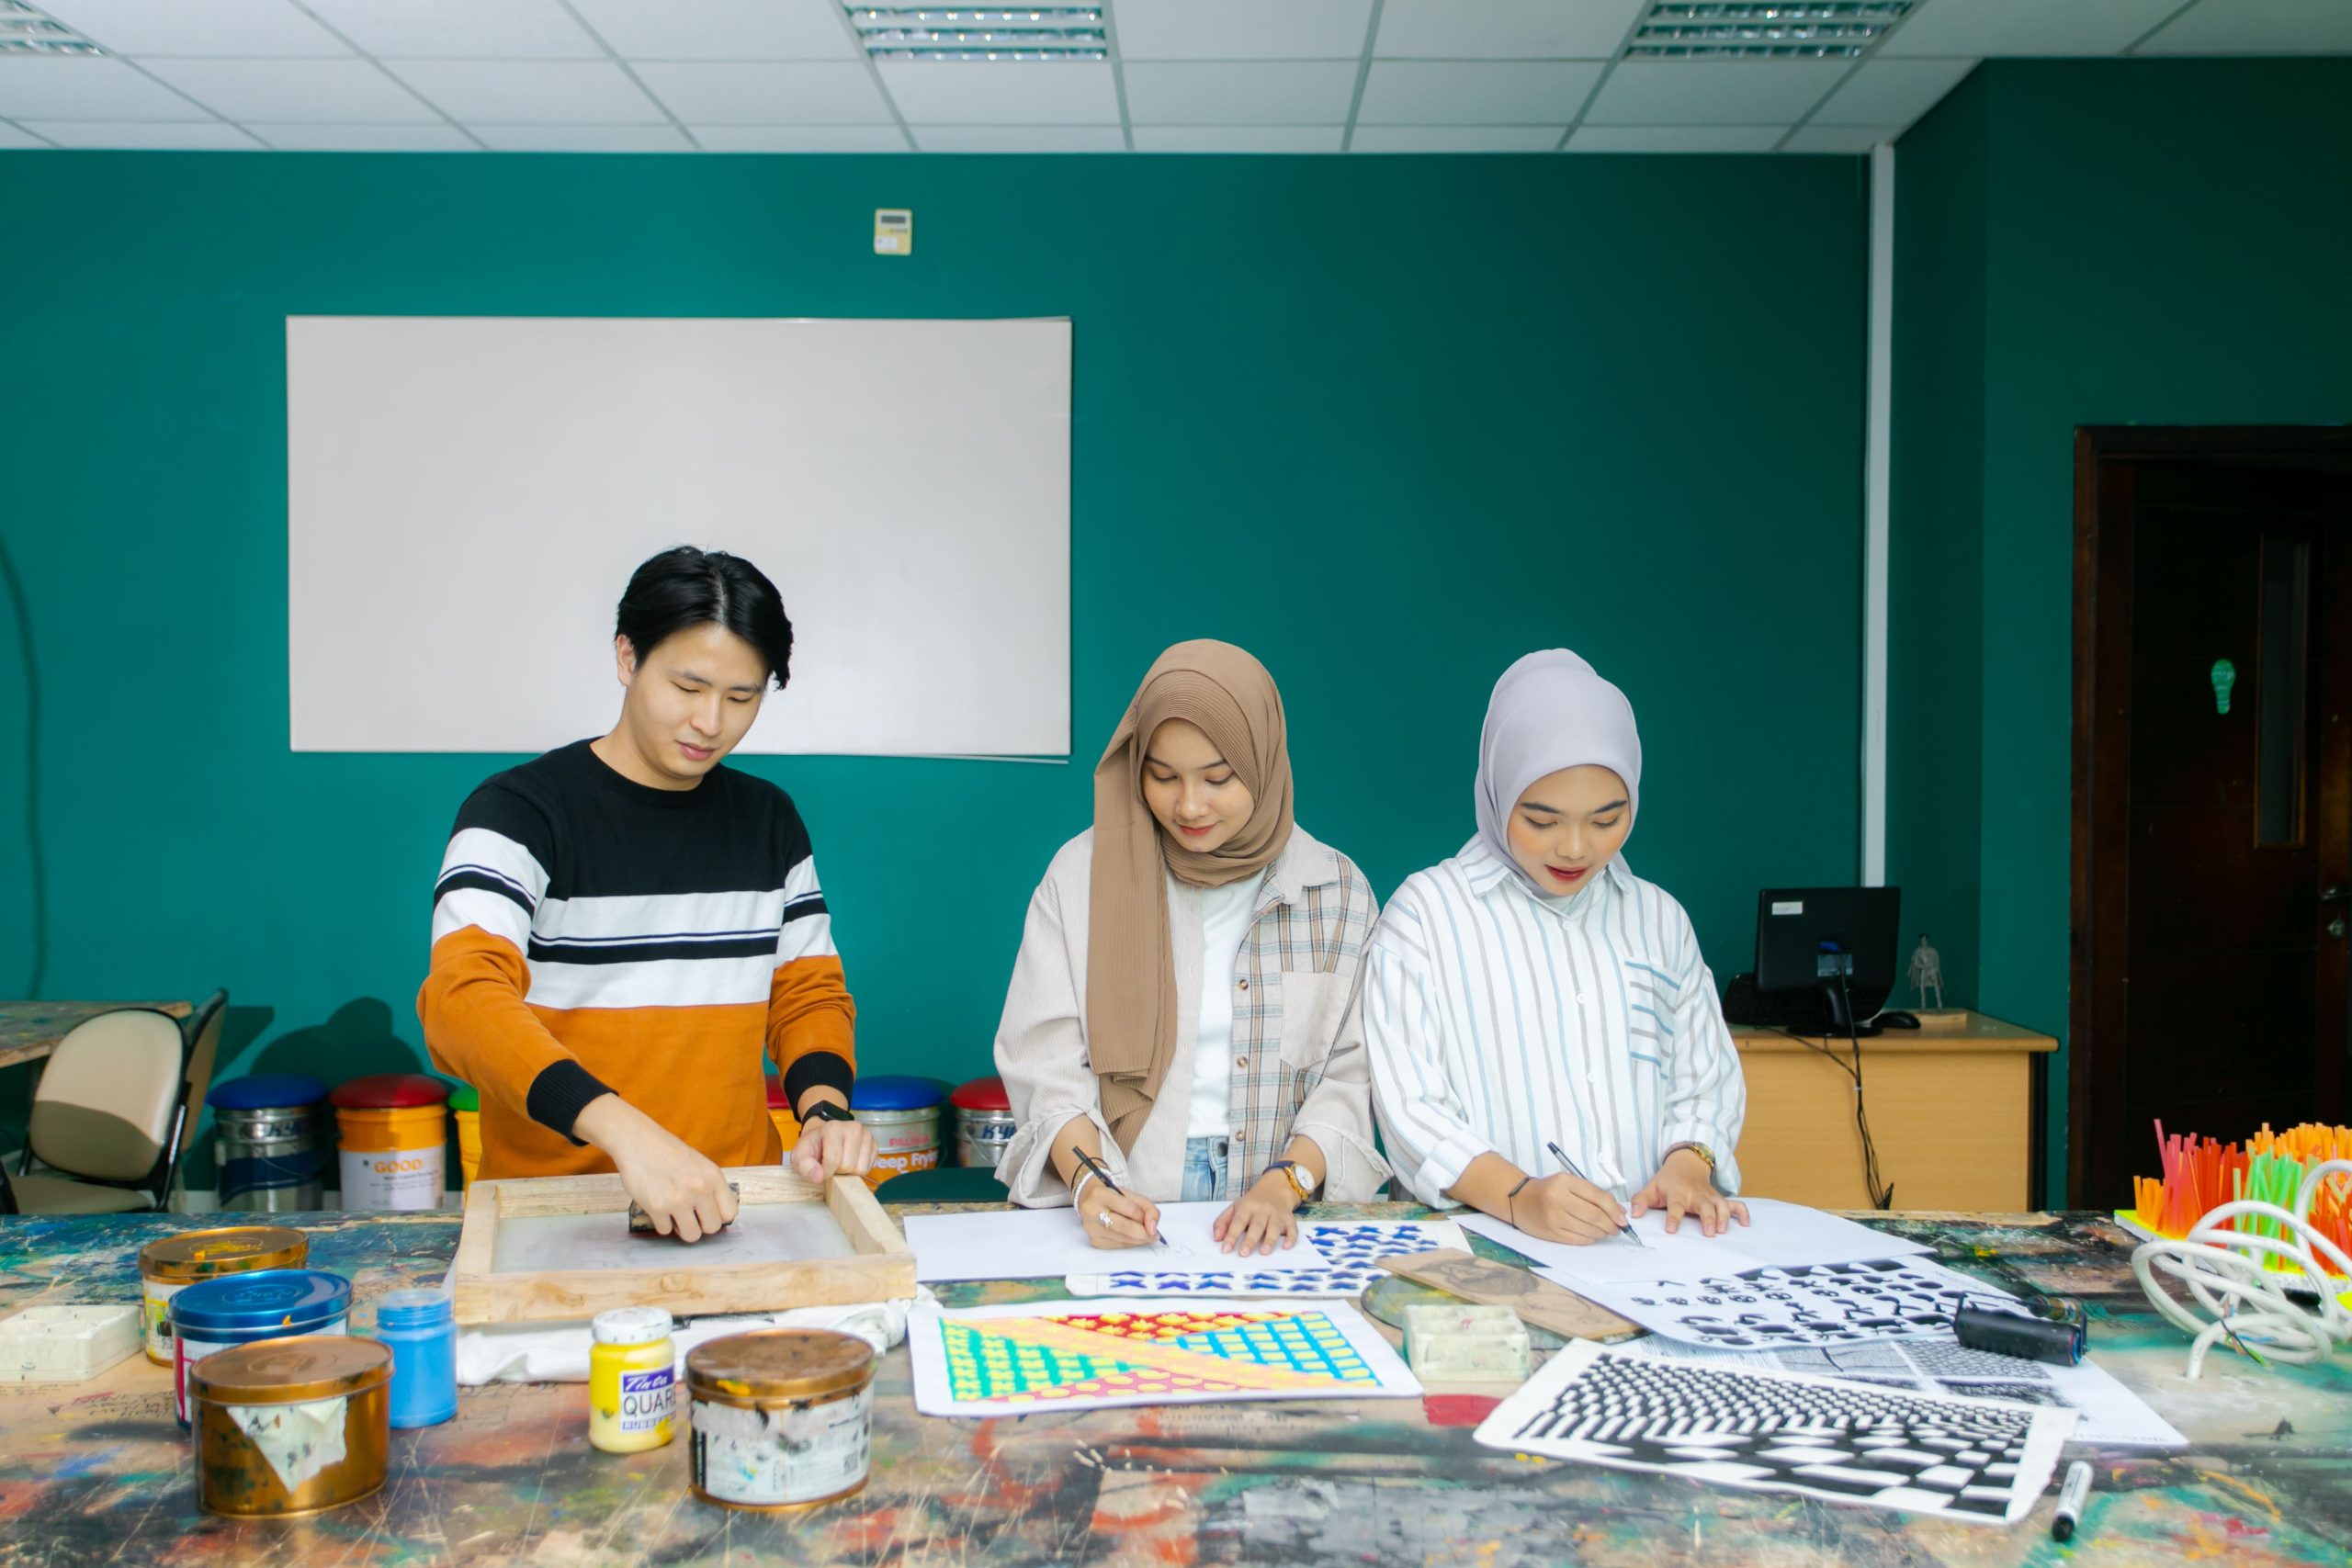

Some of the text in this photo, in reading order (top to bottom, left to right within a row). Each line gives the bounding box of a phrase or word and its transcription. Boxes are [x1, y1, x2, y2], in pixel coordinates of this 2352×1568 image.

[374, 1159, 424, 1174] GOOD
[874, 1157, 908, 1172] eep
[626, 1375, 668, 1392] Tinta
